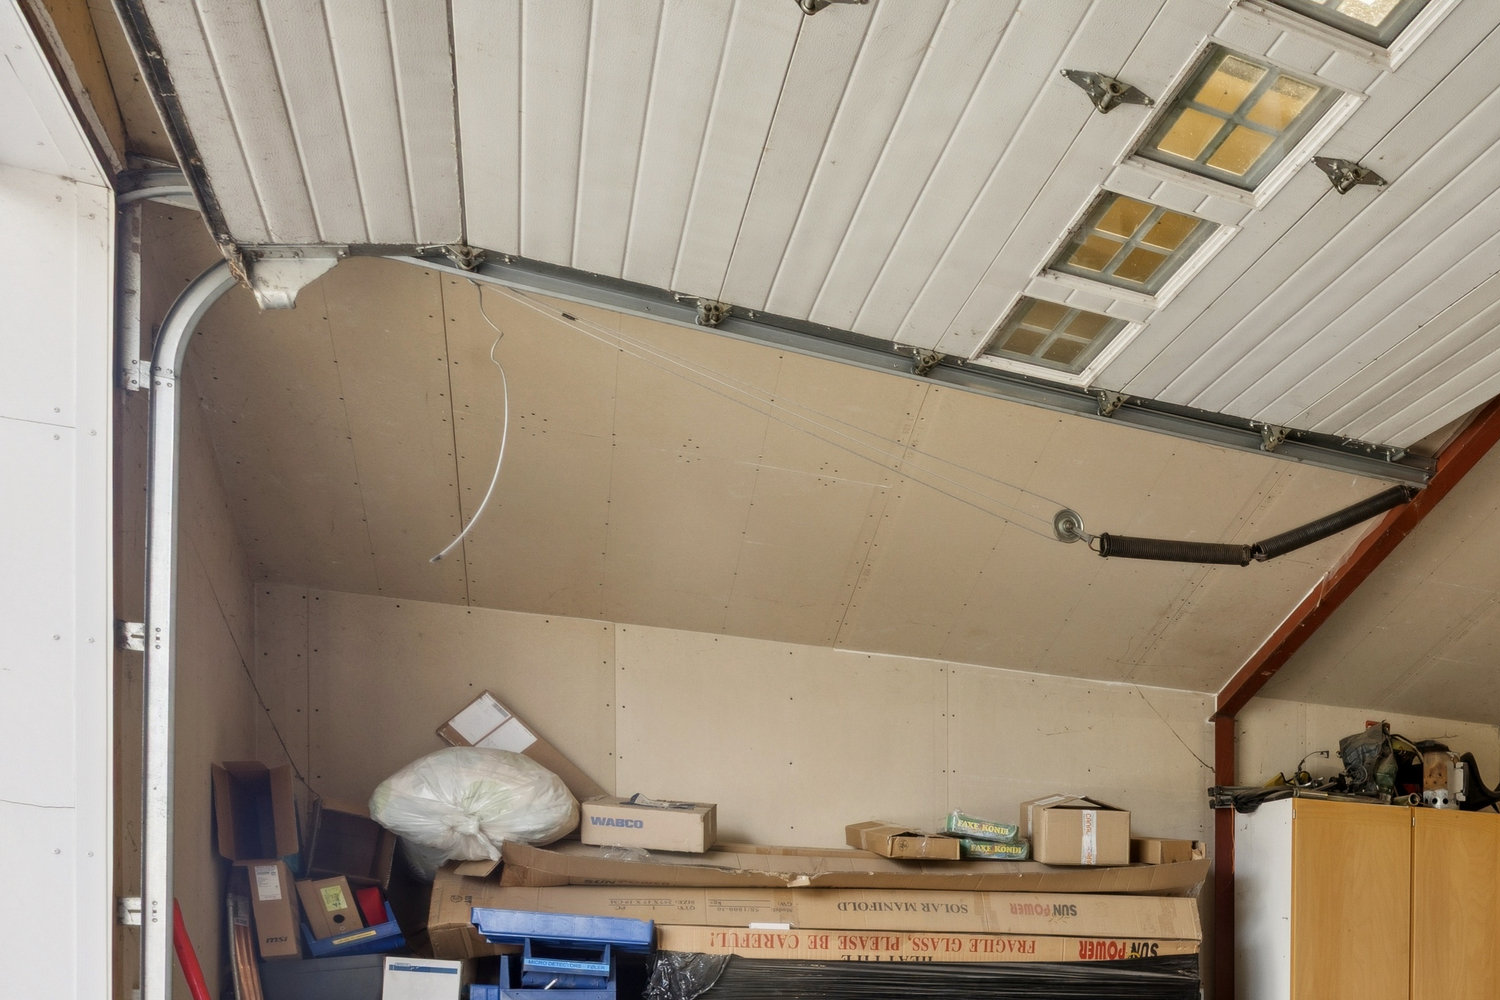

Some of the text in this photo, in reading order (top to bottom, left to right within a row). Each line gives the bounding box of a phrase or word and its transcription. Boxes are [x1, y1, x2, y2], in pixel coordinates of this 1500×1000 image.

[590, 815, 644, 829] WABCO
[957, 819, 1009, 835] FAXE KONDI
[970, 843, 1022, 855] FAXE KONDI
[837, 901, 969, 914] SOLAR MANIFOLD
[1009, 902, 1078, 917] SUN POWER
[265, 935, 288, 944] msi
[709, 931, 1036, 954] FRAGILE GLASS, PLEASE BE CAREFUL!
[1078, 940, 1159, 960] SUN POWER
